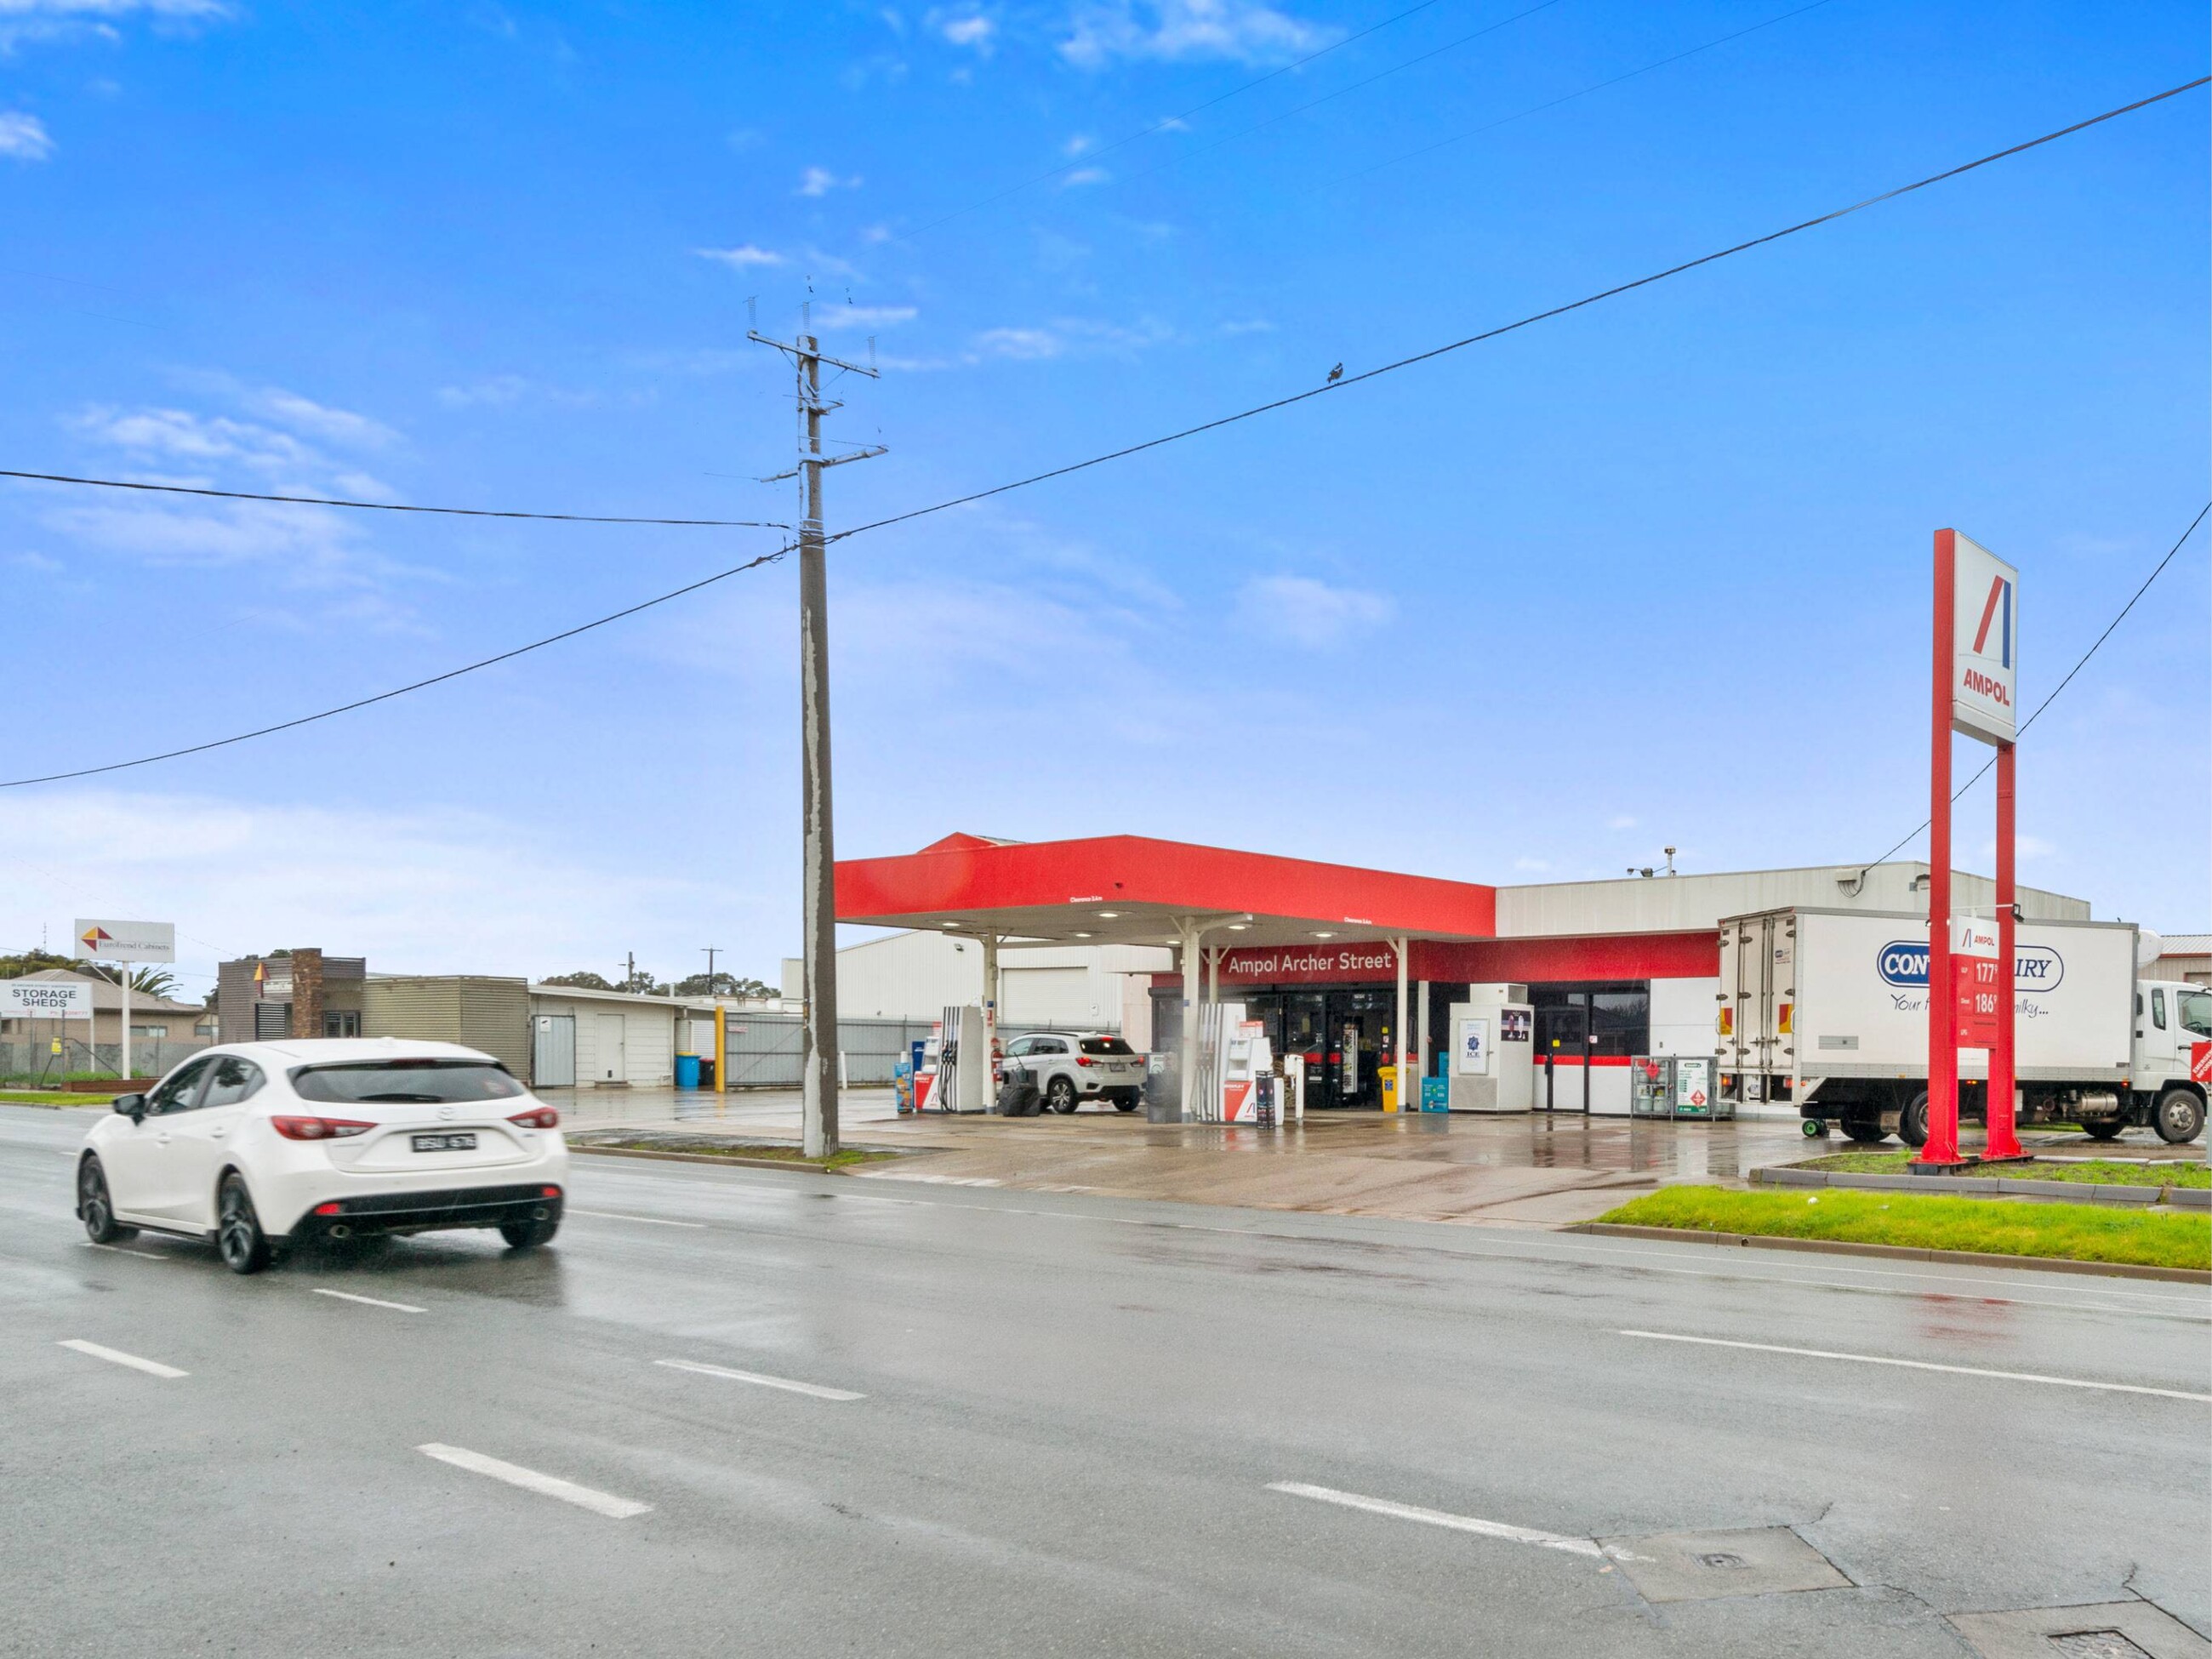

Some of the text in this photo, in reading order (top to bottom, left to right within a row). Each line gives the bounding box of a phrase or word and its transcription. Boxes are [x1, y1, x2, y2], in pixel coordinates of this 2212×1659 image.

[1964, 668, 2010, 707] AMPOL
[138, 942, 170, 951] Cabinets
[1974, 935, 1995, 946] AMPOL
[1228, 951, 1392, 977] Ampol Archer Street
[1884, 953, 2052, 978] CON IRY
[12, 989, 77, 999] STORAGE
[22, 998, 67, 1007] SHEDS
[1890, 993, 1922, 1012] Your
